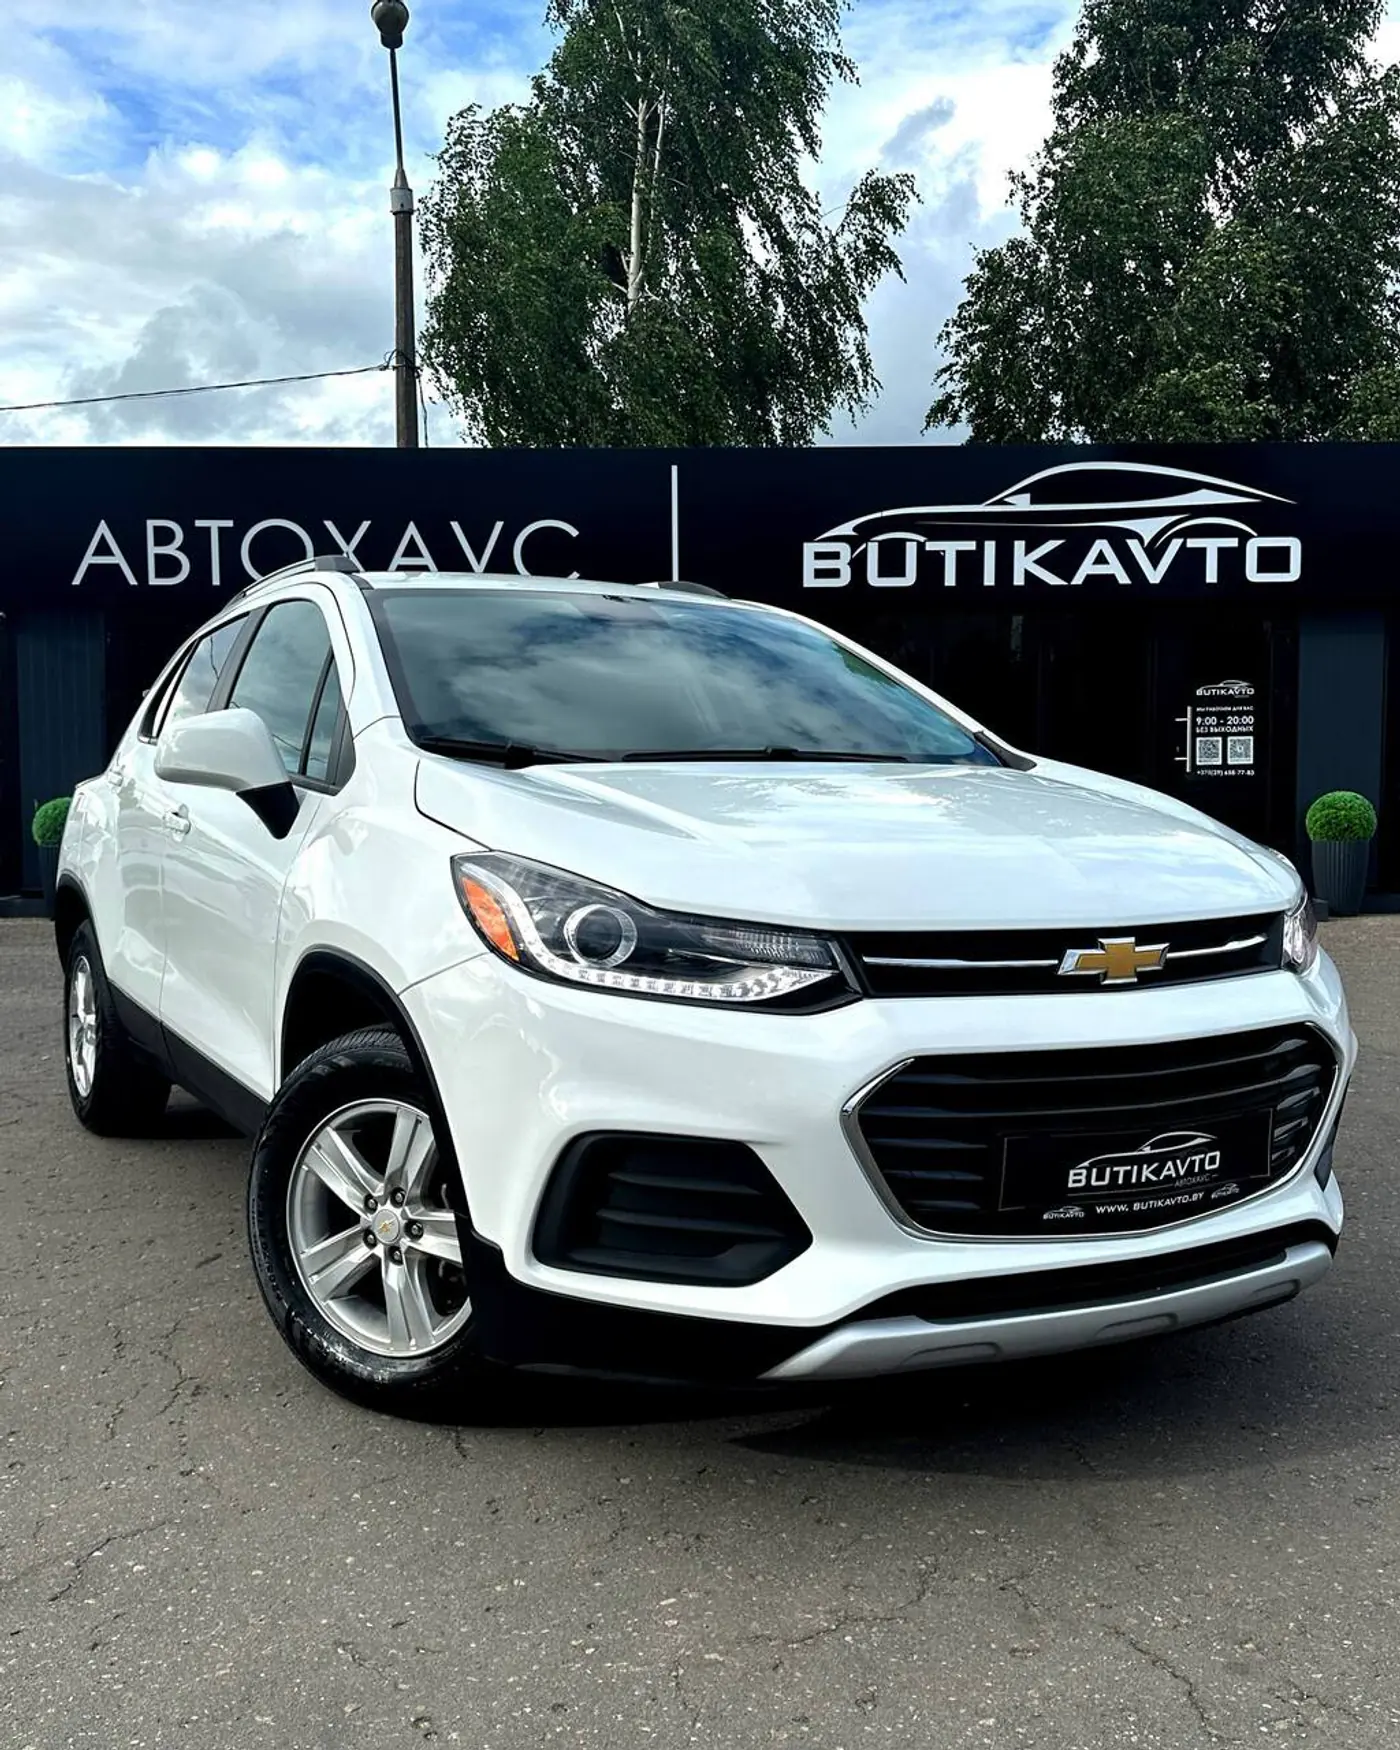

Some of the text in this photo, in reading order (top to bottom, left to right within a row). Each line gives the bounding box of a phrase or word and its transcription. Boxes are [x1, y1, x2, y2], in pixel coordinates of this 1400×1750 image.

[803, 536, 1302, 588] BUTIKAVTO
[1196, 687, 1255, 696] BUTIKAVTO
[1196, 716, 1217, 726] 9:00
[1226, 715, 1254, 725] 20:00
[1067, 1150, 1221, 1189] BUTIKAVTO
[1043, 1211, 1085, 1220] BUTIKAVTO
